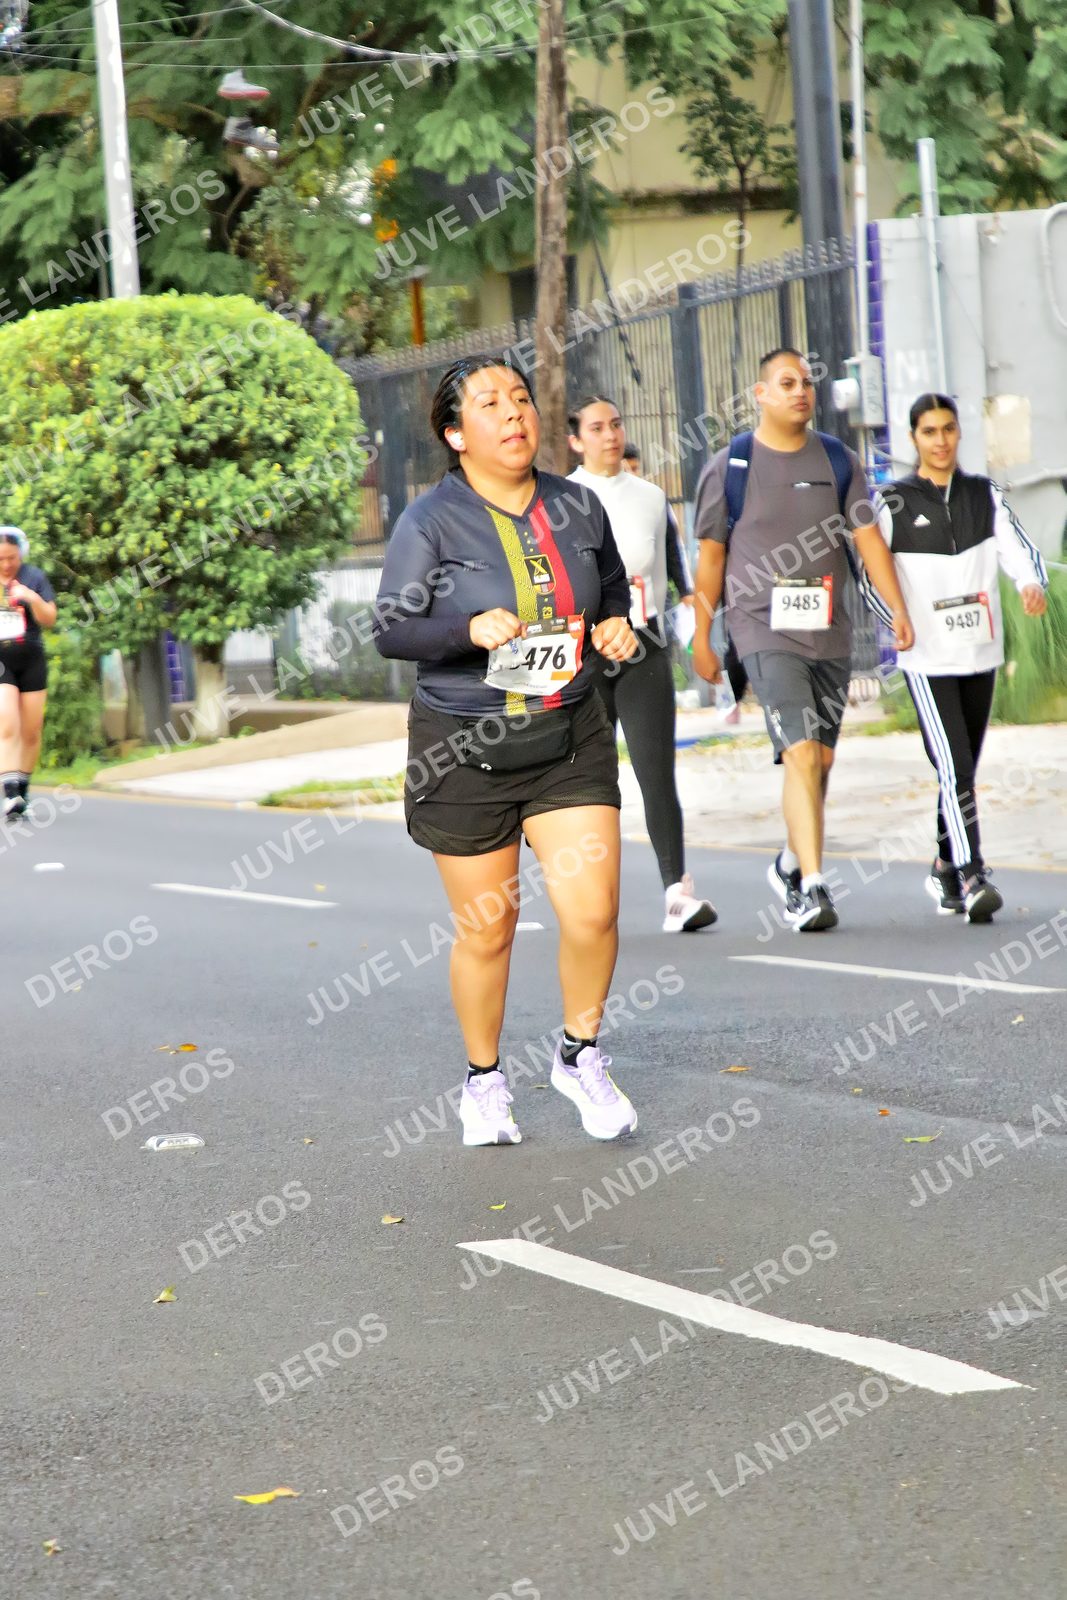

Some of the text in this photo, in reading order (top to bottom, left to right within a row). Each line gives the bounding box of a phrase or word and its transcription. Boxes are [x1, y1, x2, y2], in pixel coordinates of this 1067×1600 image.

[782, 594, 821, 611] 9485
[945, 610, 981, 631] 9487
[509, 645, 567, 671] 476
